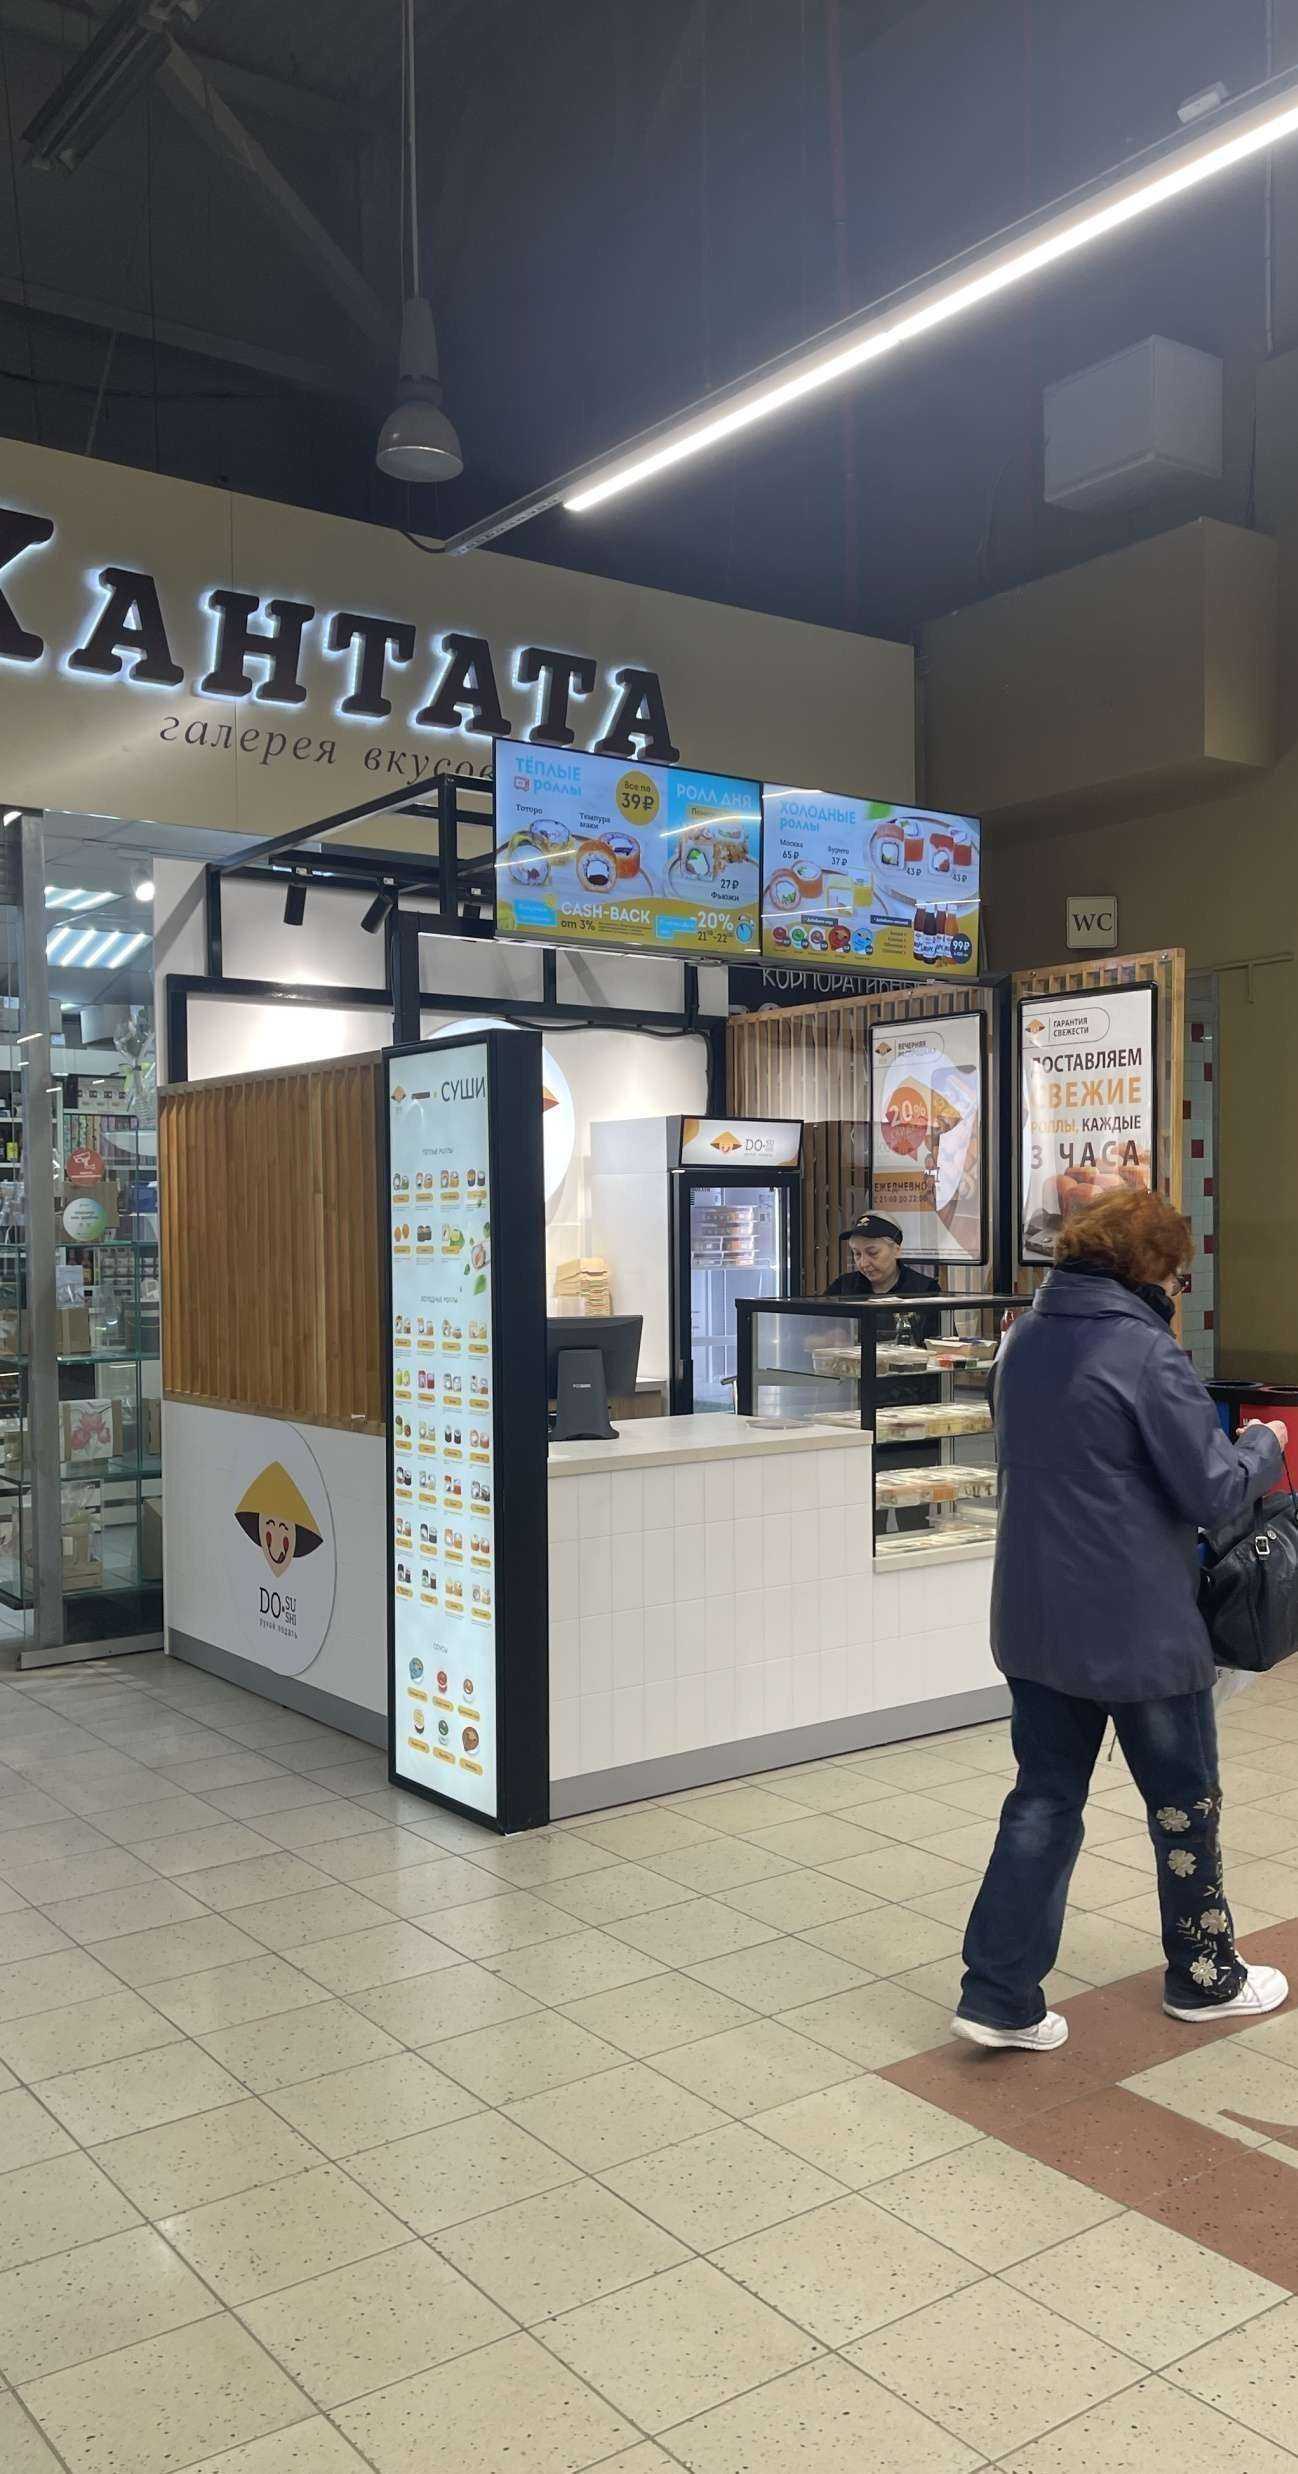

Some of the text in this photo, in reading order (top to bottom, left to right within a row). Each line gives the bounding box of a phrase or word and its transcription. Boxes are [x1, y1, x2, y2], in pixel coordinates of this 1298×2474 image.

[160, 714, 337, 767] галерея
[515, 755, 581, 780] ТЁПЛЫЕ
[624, 780, 639, 790] Все
[676, 783, 752, 809] РОЛЛ ДНЯ
[780, 801, 857, 825] ХОЛОДНЫЕ
[561, 901, 651, 923] CASH-BACK
[1072, 912, 1113, 932] WC
[579, 919, 596, 931] 3%
[1053, 1017, 1088, 1027] ГАРАНТИЯ
[1053, 1027, 1089, 1038] СВЕЖЕСТИ
[1032, 1048, 1142, 1073] ОСТАВЛЯЕМ
[441, 1077, 485, 1102] СУШИ
[1031, 1076, 1142, 1109] ВЕЖИЕ
[1082, 1115, 1141, 1133] КАЖДЫЕ
[1031, 1140, 1140, 1169] 3 ЧАСА
[874, 1181, 928, 1193] ЕЖЕДНЕВНО
